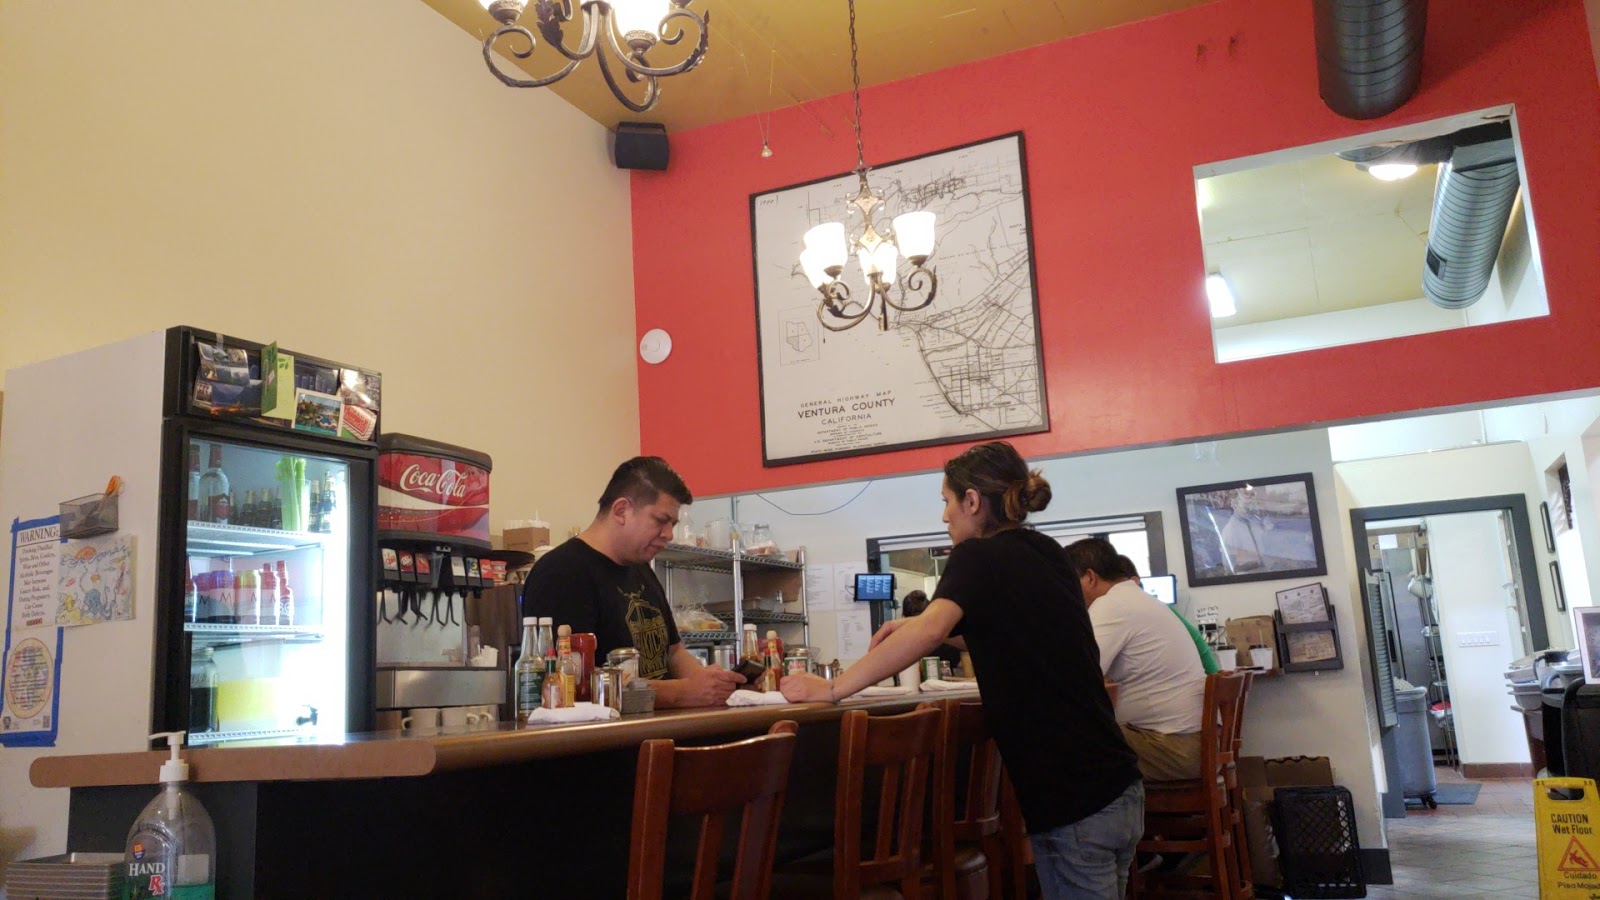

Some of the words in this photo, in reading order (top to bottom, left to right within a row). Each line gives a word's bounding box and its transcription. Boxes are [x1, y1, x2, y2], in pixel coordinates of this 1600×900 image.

[800, 400, 832, 408] GENERAL
[837, 394, 869, 403] HIGHWAY
[797, 406, 846, 419] VENTURA
[852, 398, 896, 411] COUNTY
[821, 413, 872, 425] CALIFORNIA
[400, 463, 468, 498] Coca-Cola
[19, 526, 59, 543] WARNING:
[1551, 814, 1588, 824] CAUTION
[1553, 825, 1570, 834] Wet
[1572, 825, 1592, 834] Floor
[128, 862, 166, 877] HAND
[1564, 872, 1597, 880] Cuidado
